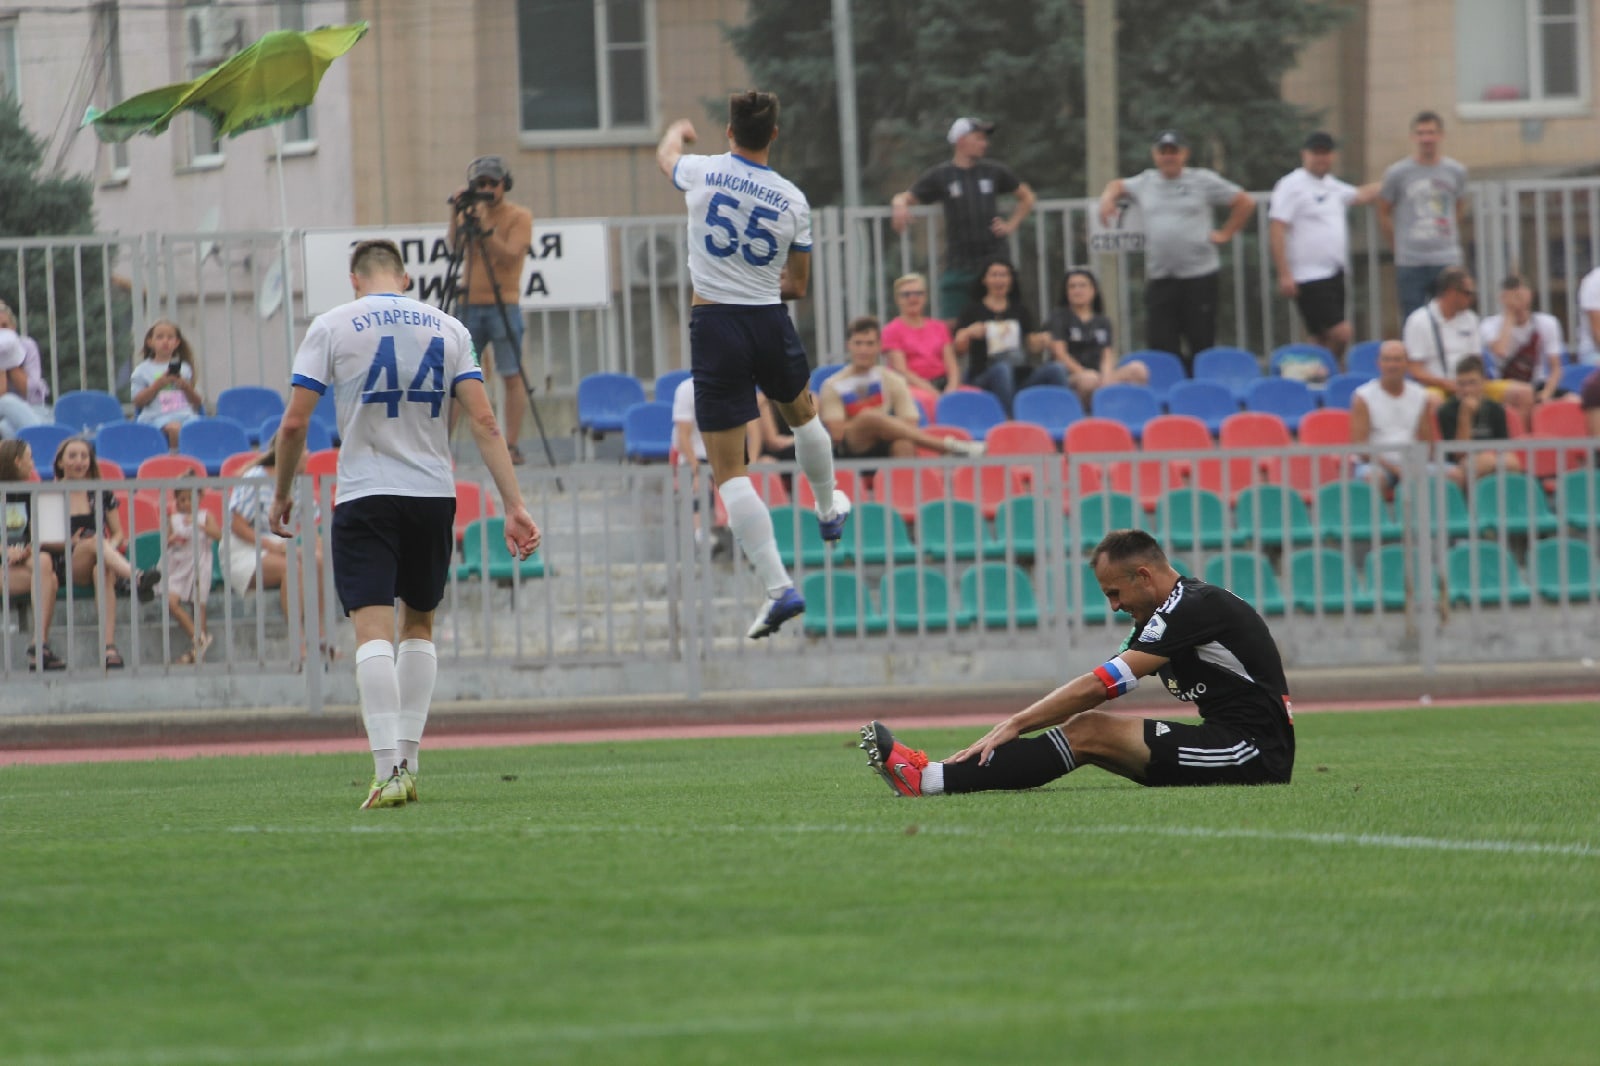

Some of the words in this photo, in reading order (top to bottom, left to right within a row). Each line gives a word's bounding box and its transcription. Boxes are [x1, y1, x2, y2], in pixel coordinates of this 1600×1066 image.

[705, 172, 790, 213] МАКСИМЕНКО
[704, 191, 780, 267] 55
[351, 308, 442, 332] БУТАРЕВИЧ
[361, 335, 446, 419] 44
